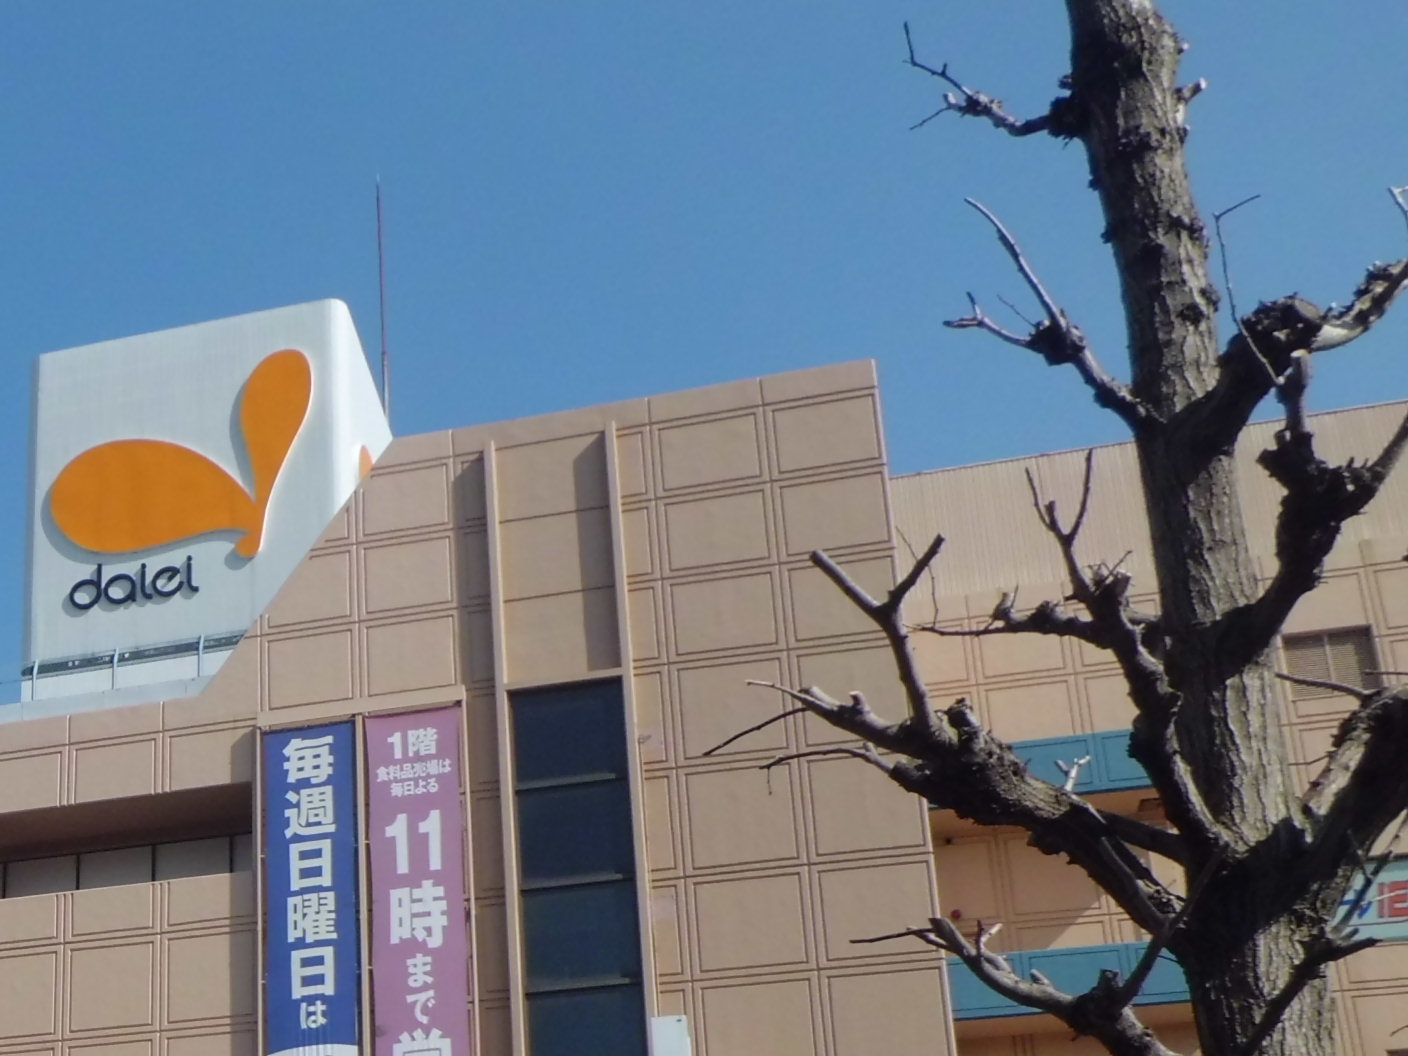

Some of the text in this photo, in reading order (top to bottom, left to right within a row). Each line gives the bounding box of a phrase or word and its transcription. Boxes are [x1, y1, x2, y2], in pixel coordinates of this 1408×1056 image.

[69, 555, 199, 610] daiei
[387, 727, 438, 759] 1階
[390, 778, 439, 797] 毎日よる
[282, 734, 338, 1029] 毎週日曜日は
